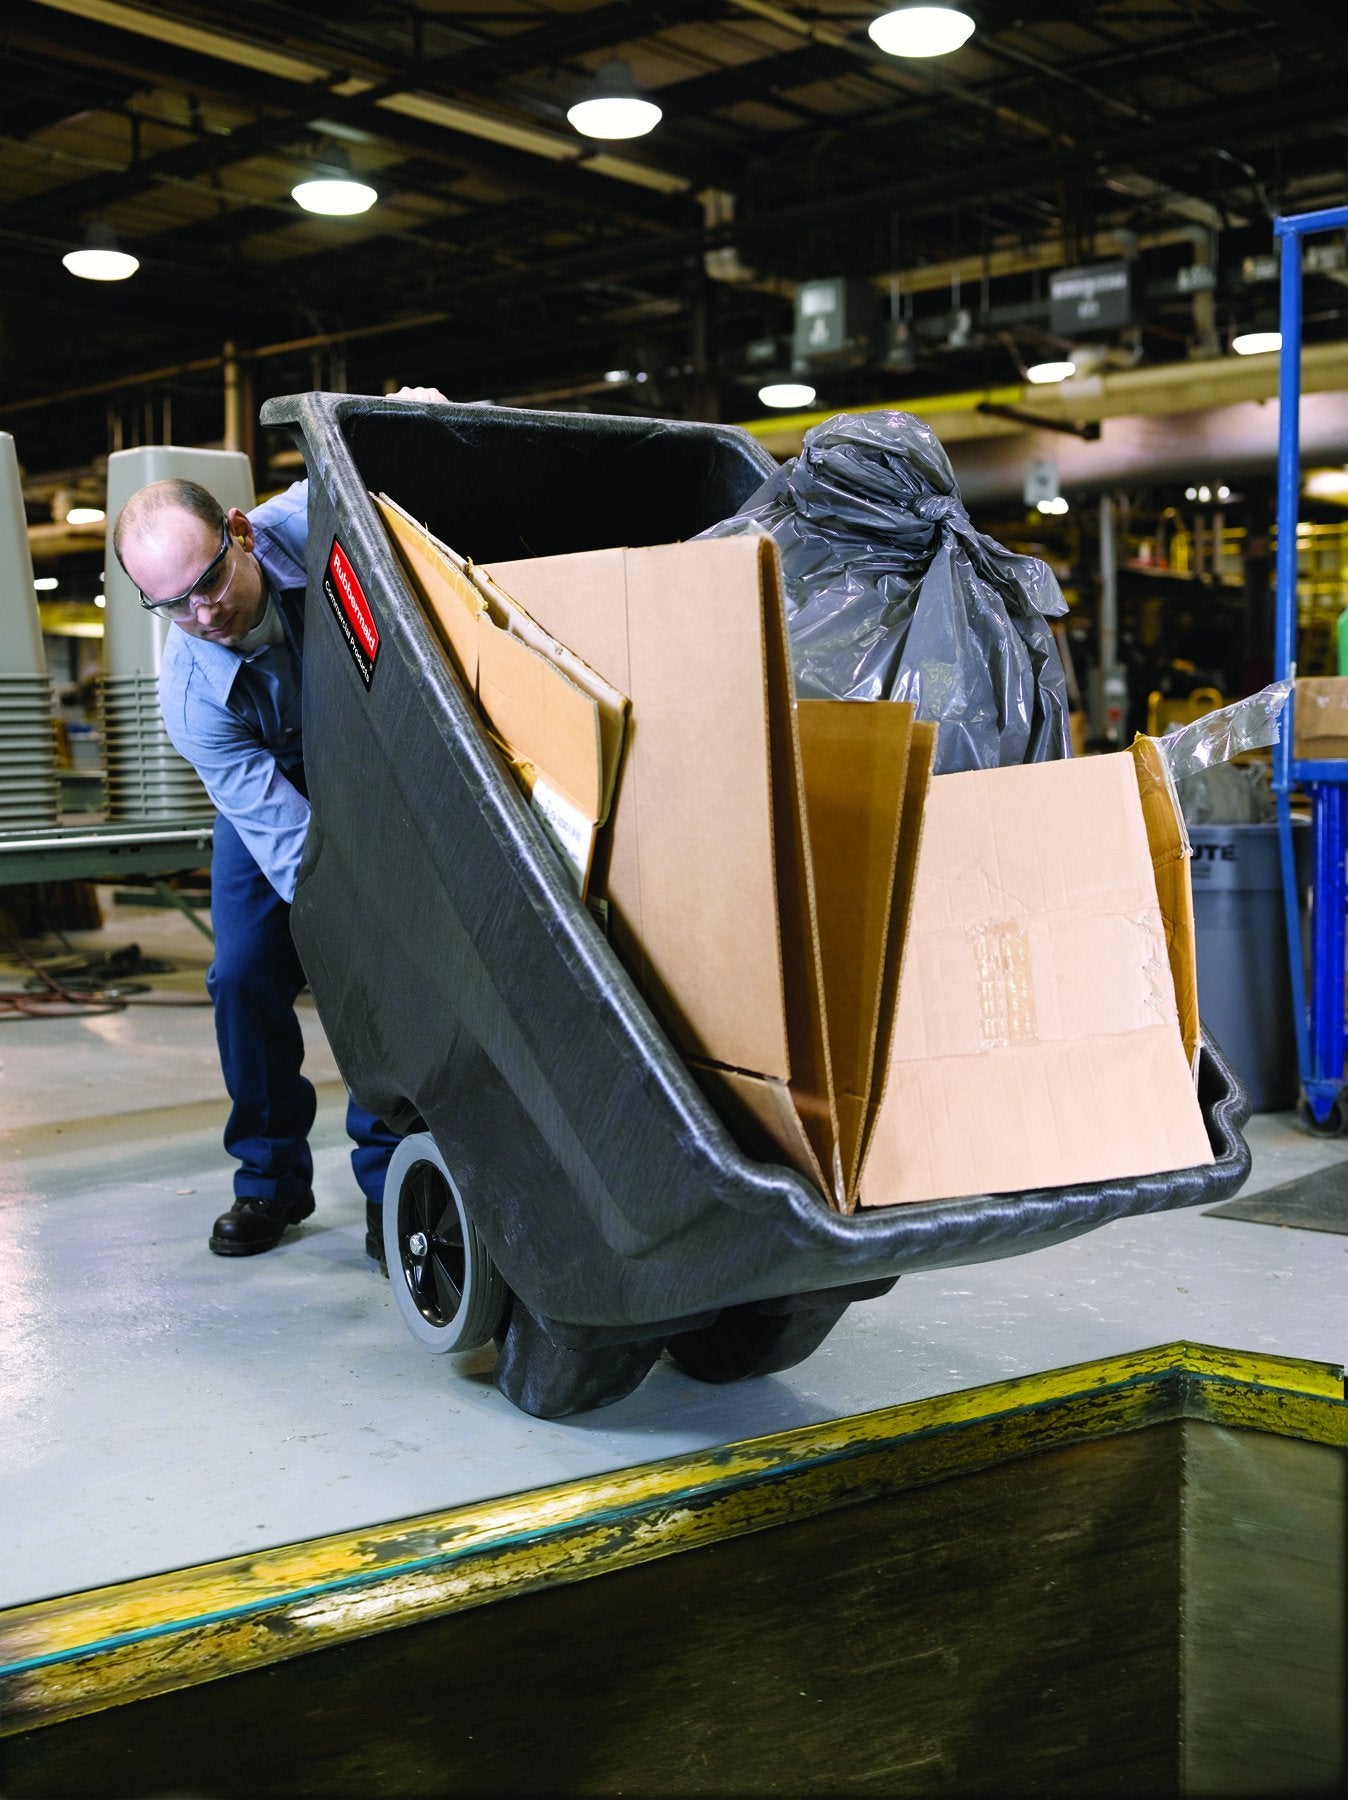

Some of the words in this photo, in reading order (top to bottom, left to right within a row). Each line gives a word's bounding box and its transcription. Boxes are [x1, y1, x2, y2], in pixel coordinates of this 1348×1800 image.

[325, 580, 351, 639] Commercial
[350, 639, 370, 683] Products
[333, 553, 376, 650] Rubbermaid
